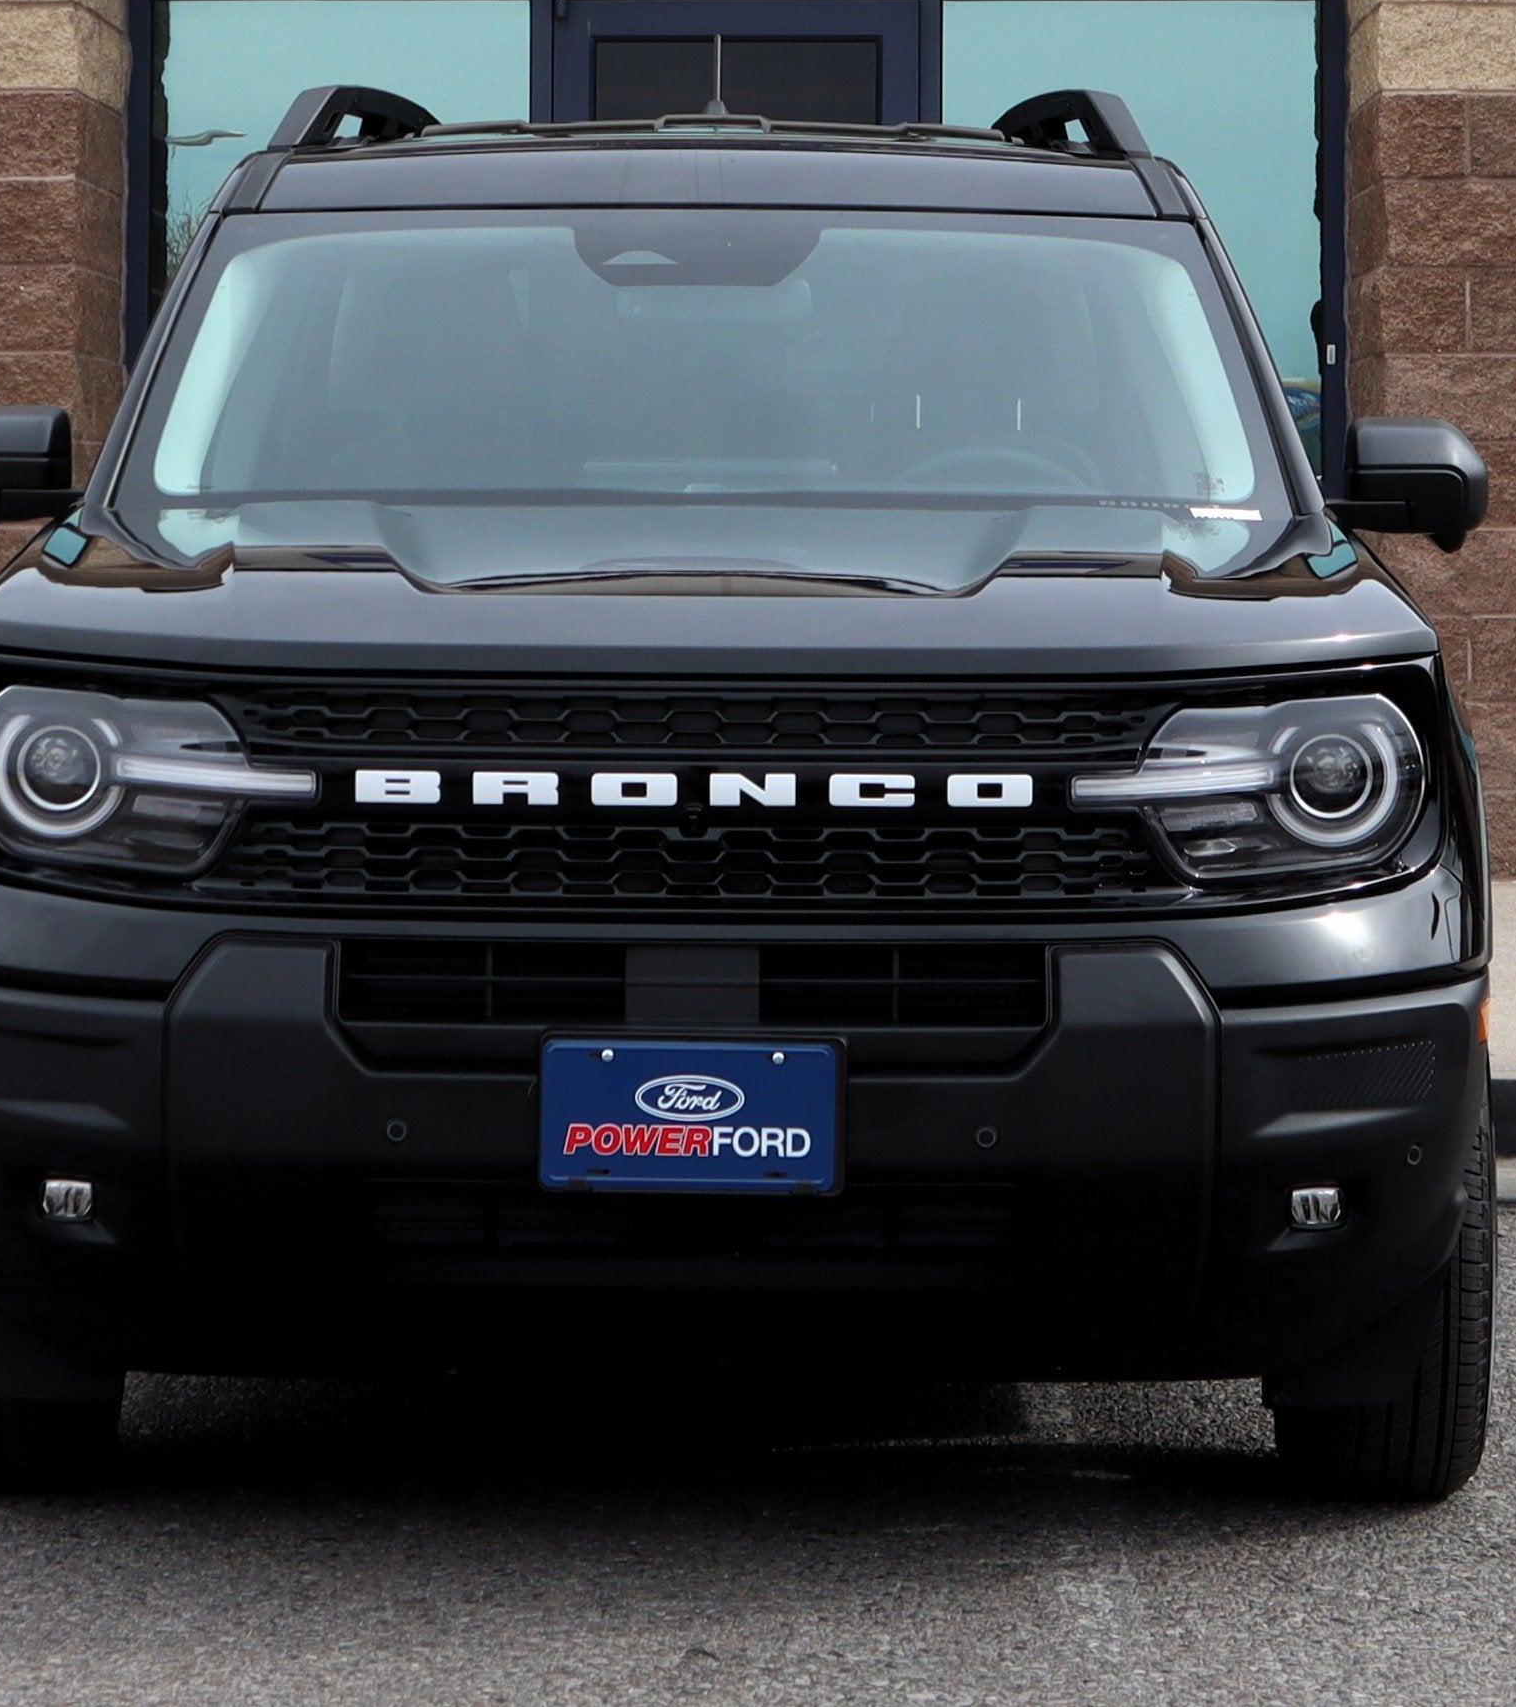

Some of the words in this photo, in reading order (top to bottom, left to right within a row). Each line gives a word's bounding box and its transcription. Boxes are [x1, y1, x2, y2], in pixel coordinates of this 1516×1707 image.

[354, 769, 1033, 807] BRONCO
[657, 1083, 722, 1110] Ford
[563, 1123, 811, 1158] POWERFORD
